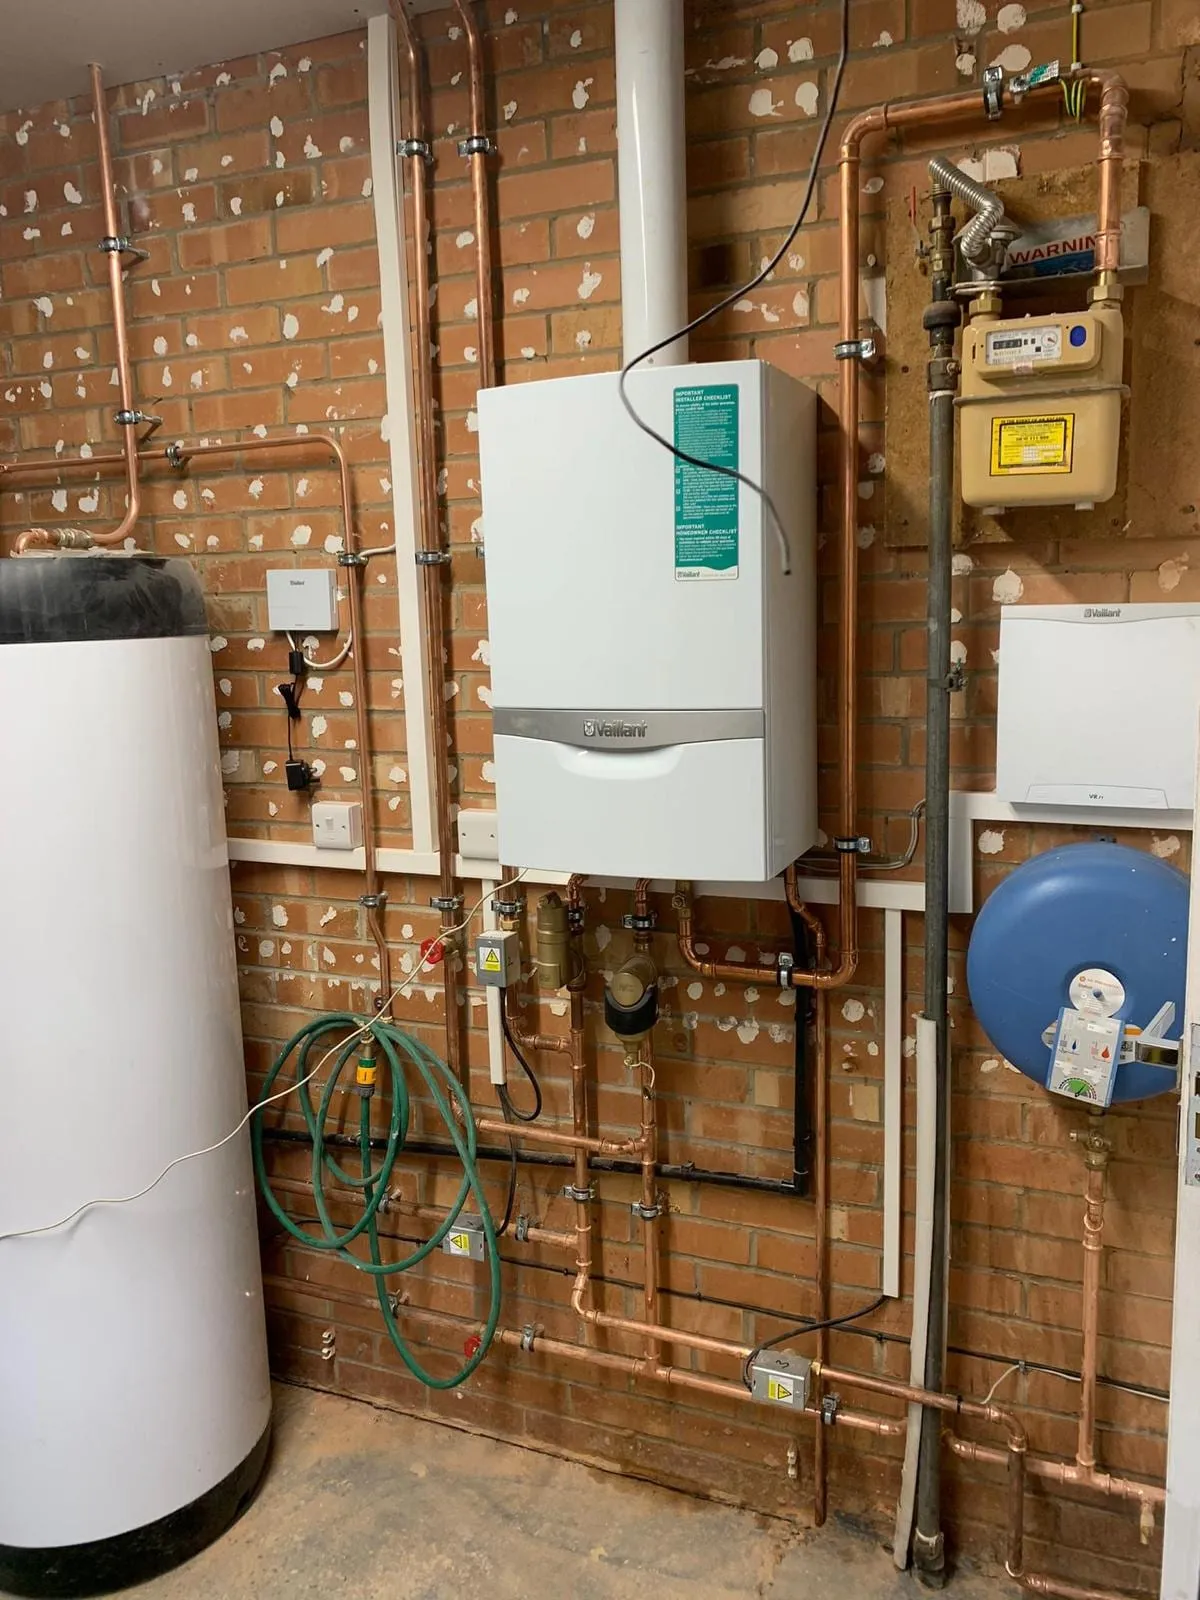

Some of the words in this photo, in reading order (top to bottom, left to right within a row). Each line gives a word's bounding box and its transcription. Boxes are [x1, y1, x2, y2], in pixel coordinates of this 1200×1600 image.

[1009, 235, 1096, 264] WARNIN
[1092, 608, 1121, 617] Vaillant
[597, 719, 648, 737] Vaillant
